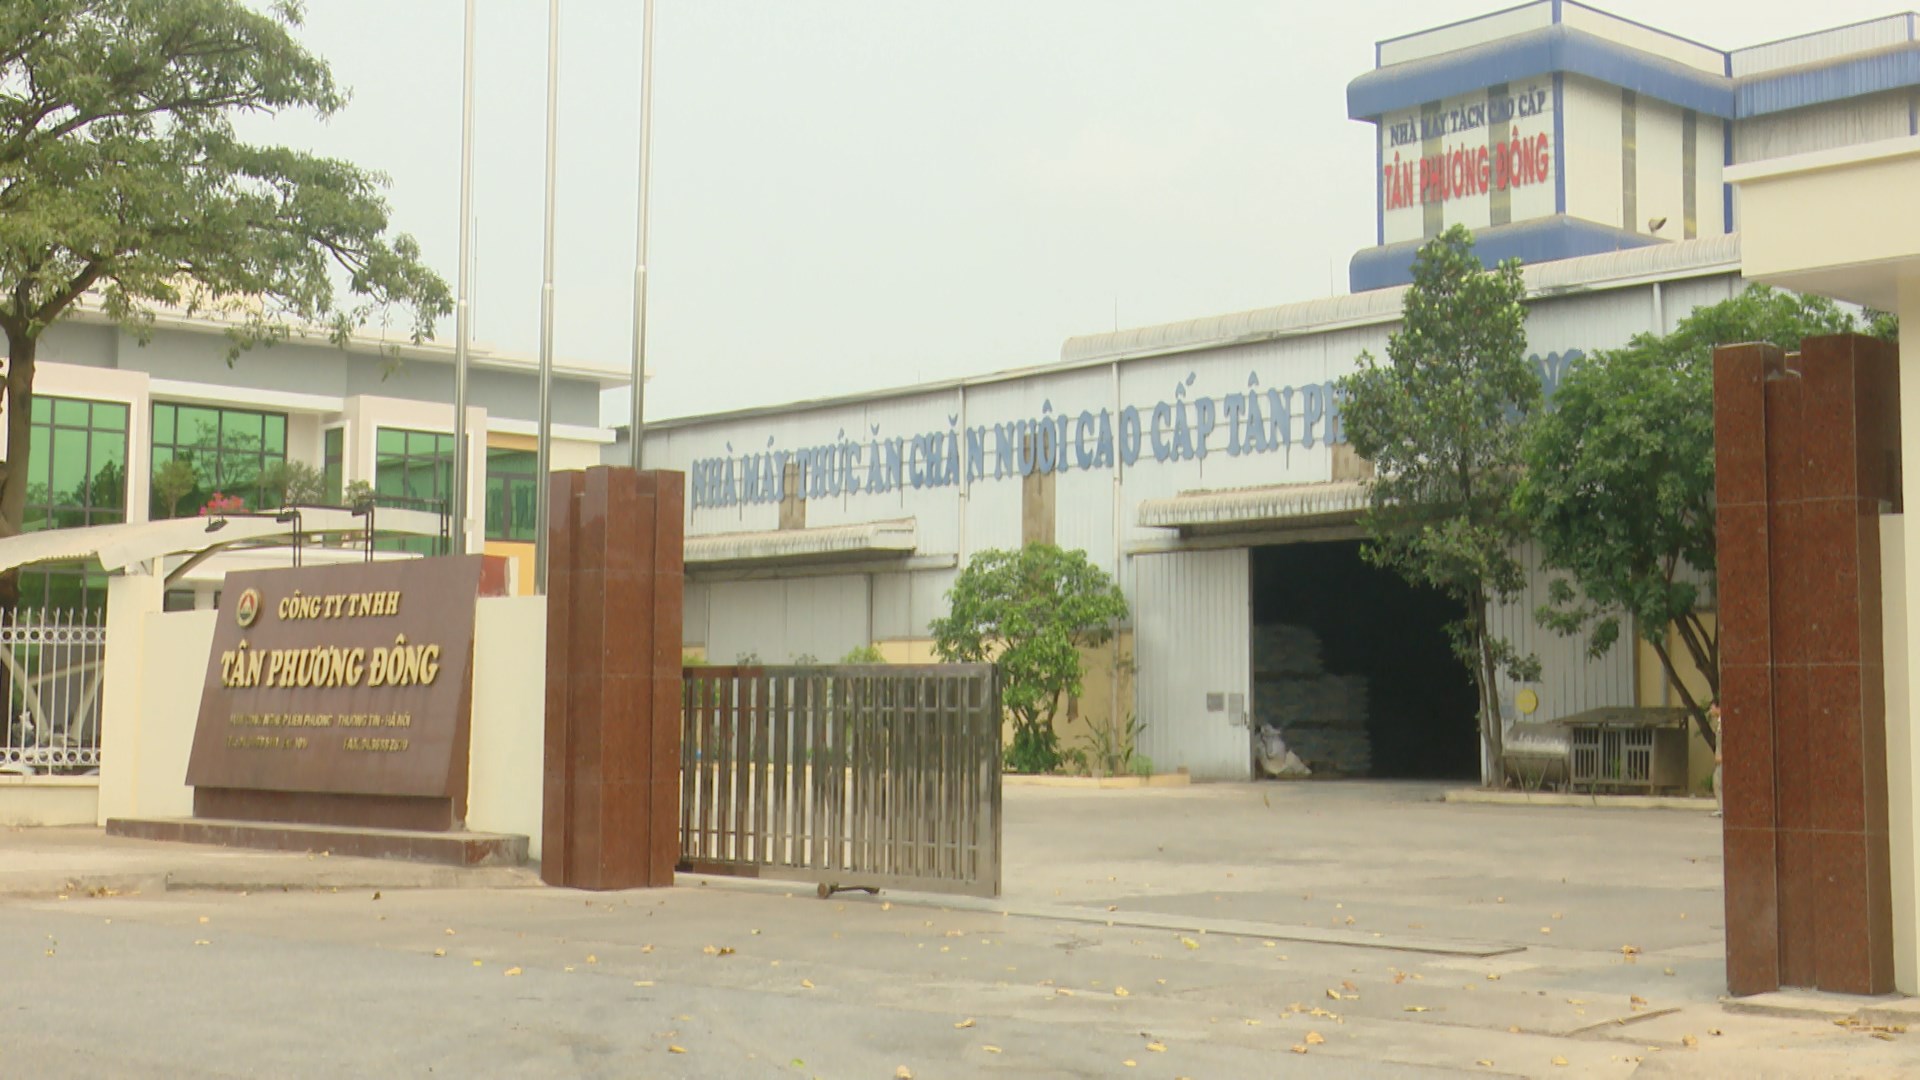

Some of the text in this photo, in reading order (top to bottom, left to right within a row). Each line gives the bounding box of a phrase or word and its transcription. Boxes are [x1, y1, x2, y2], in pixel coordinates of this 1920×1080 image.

[1385, 125, 1549, 211] TÂN PHƯƠNG ĐÔNG
[692, 441, 738, 510] NHÀ
[742, 435, 790, 505] MÁY
[797, 428, 862, 500] THỨC
[865, 423, 903, 495] ĂN
[994, 398, 1069, 477] NUÔI
[1074, 405, 1141, 470] CAO
[1151, 371, 1215, 463] CẤP
[1224, 370, 1294, 457] TÂN
[278, 589, 401, 620] CÔNG TY TNHH
[221, 633, 440, 688] TÂN PHƯƠNG ĐÔNG
